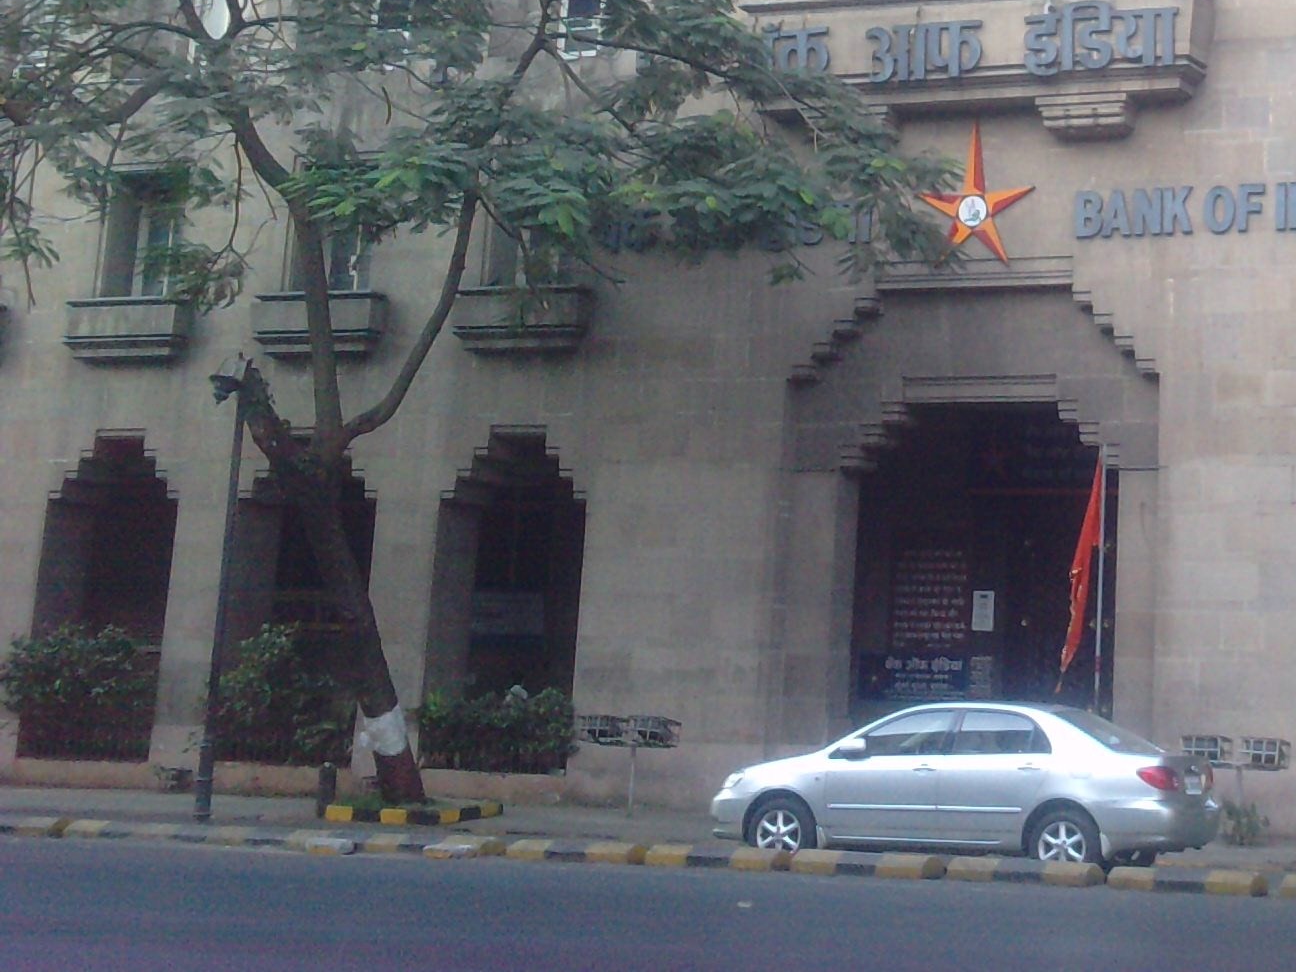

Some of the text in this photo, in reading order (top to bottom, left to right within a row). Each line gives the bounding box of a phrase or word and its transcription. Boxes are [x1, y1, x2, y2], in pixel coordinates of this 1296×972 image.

[1024, 0, 1179, 76] इंडिया
[1075, 185, 1194, 239] BANK
[1203, 183, 1266, 234] OF
